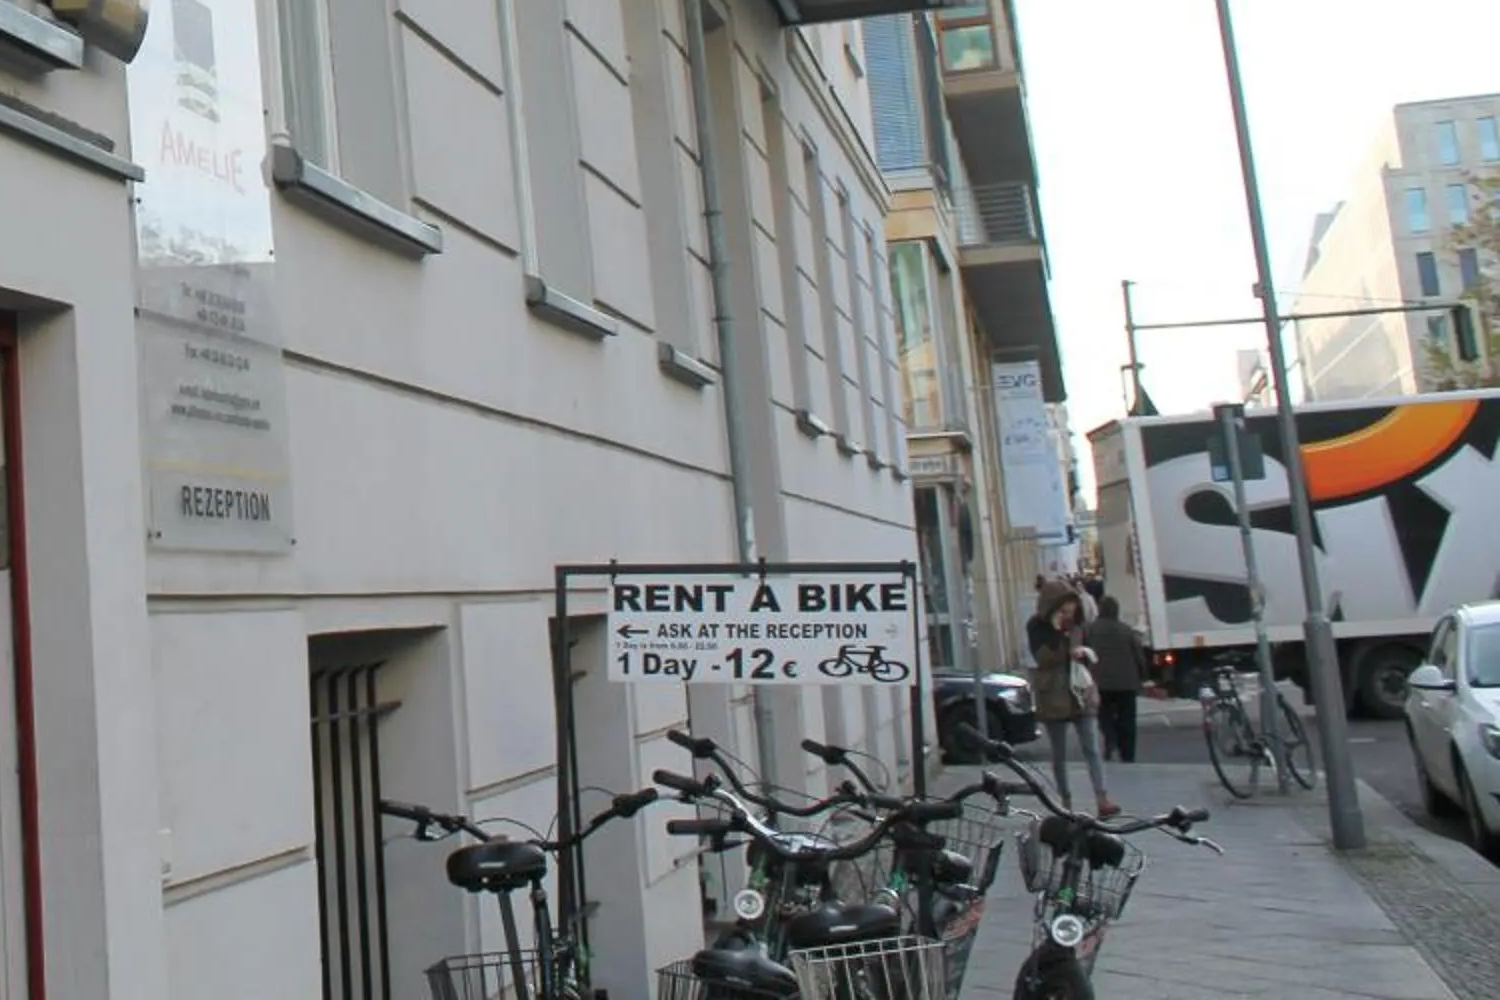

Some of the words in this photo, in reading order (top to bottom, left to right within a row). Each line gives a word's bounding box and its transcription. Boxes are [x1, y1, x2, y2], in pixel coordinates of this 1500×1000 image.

[181, 485, 271, 520] REZEPTION
[613, 584, 734, 612] RENT
[750, 583, 781, 612] A
[798, 583, 907, 612] BIKE
[657, 624, 693, 638] ASK
[698, 624, 720, 638] AT
[725, 624, 760, 638] THE
[766, 624, 868, 639] RECEPTION
[617, 653, 630, 674] 1
[643, 653, 698, 681] Day
